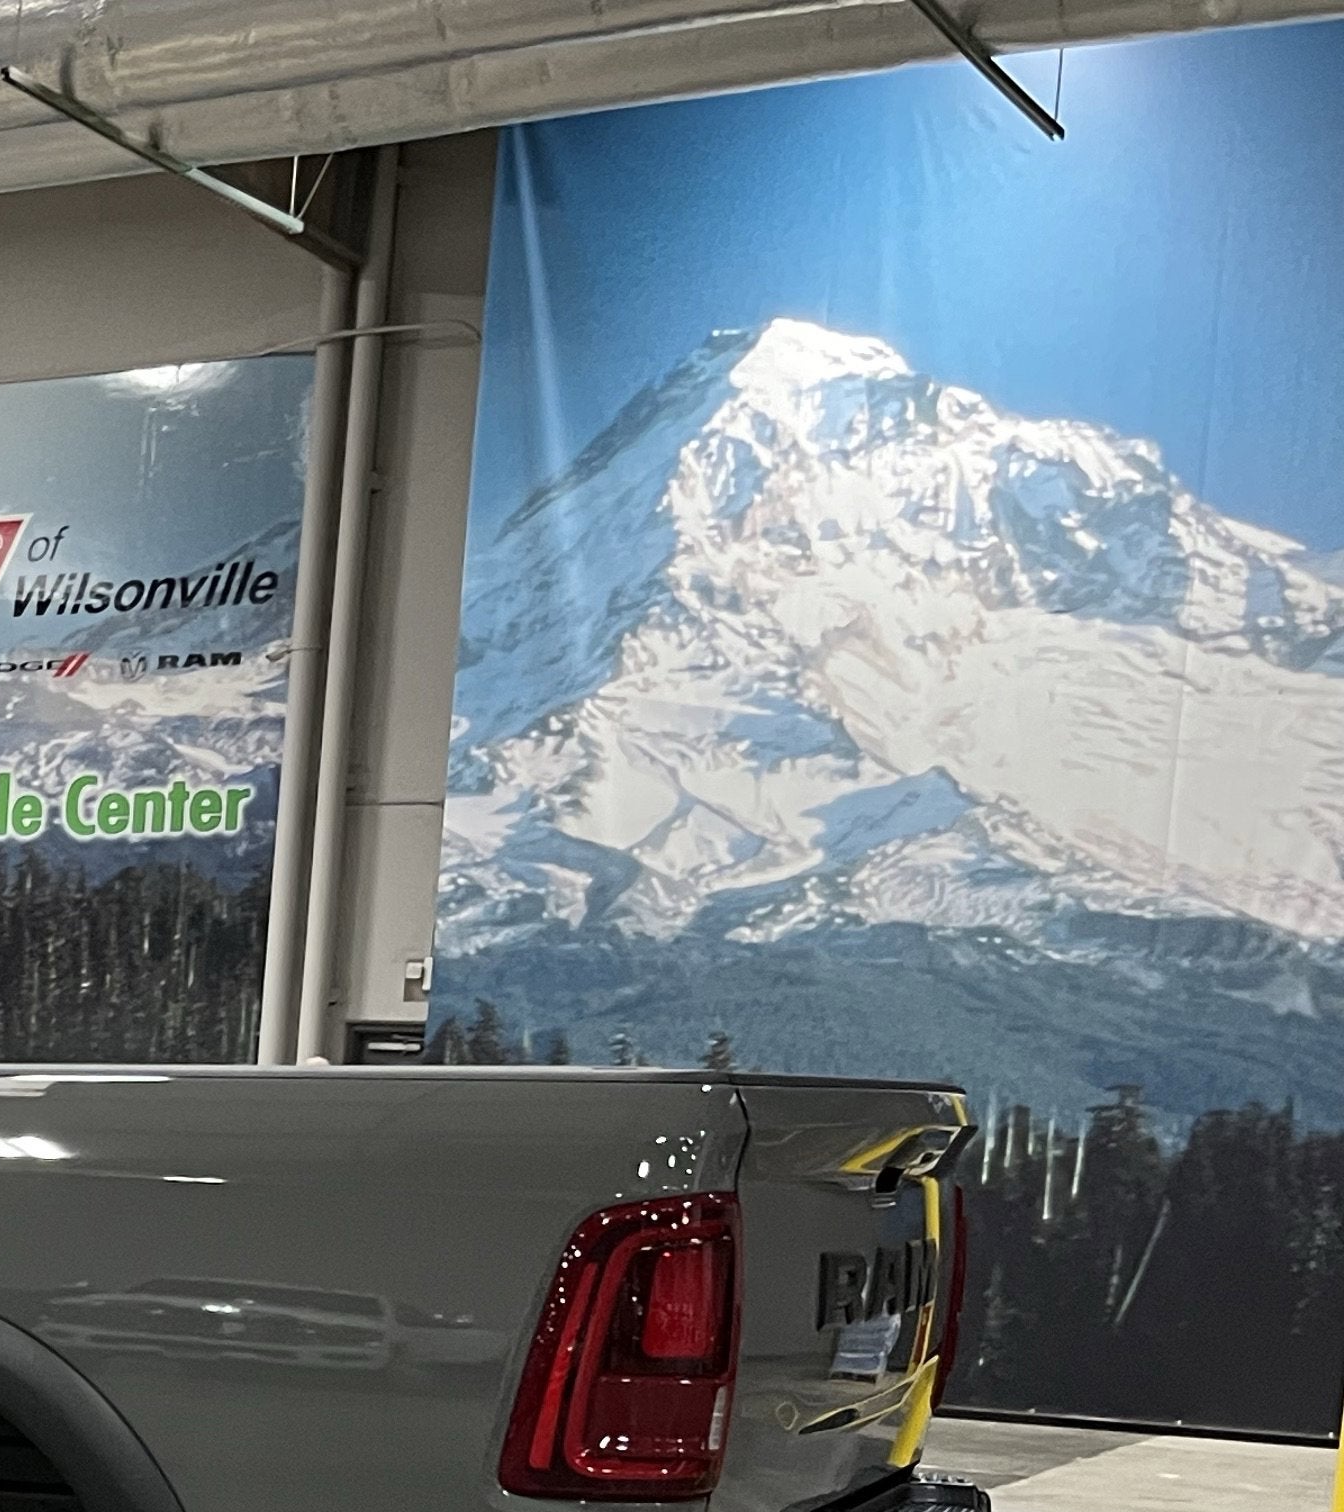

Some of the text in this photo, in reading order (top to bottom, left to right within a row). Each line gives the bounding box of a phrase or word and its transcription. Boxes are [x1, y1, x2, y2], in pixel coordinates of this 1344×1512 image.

[27, 525, 70, 562] of
[12, 561, 278, 619] Wilsonville
[157, 651, 242, 671] RAM
[65, 775, 251, 835] Center
[817, 1238, 939, 1331] RAM
